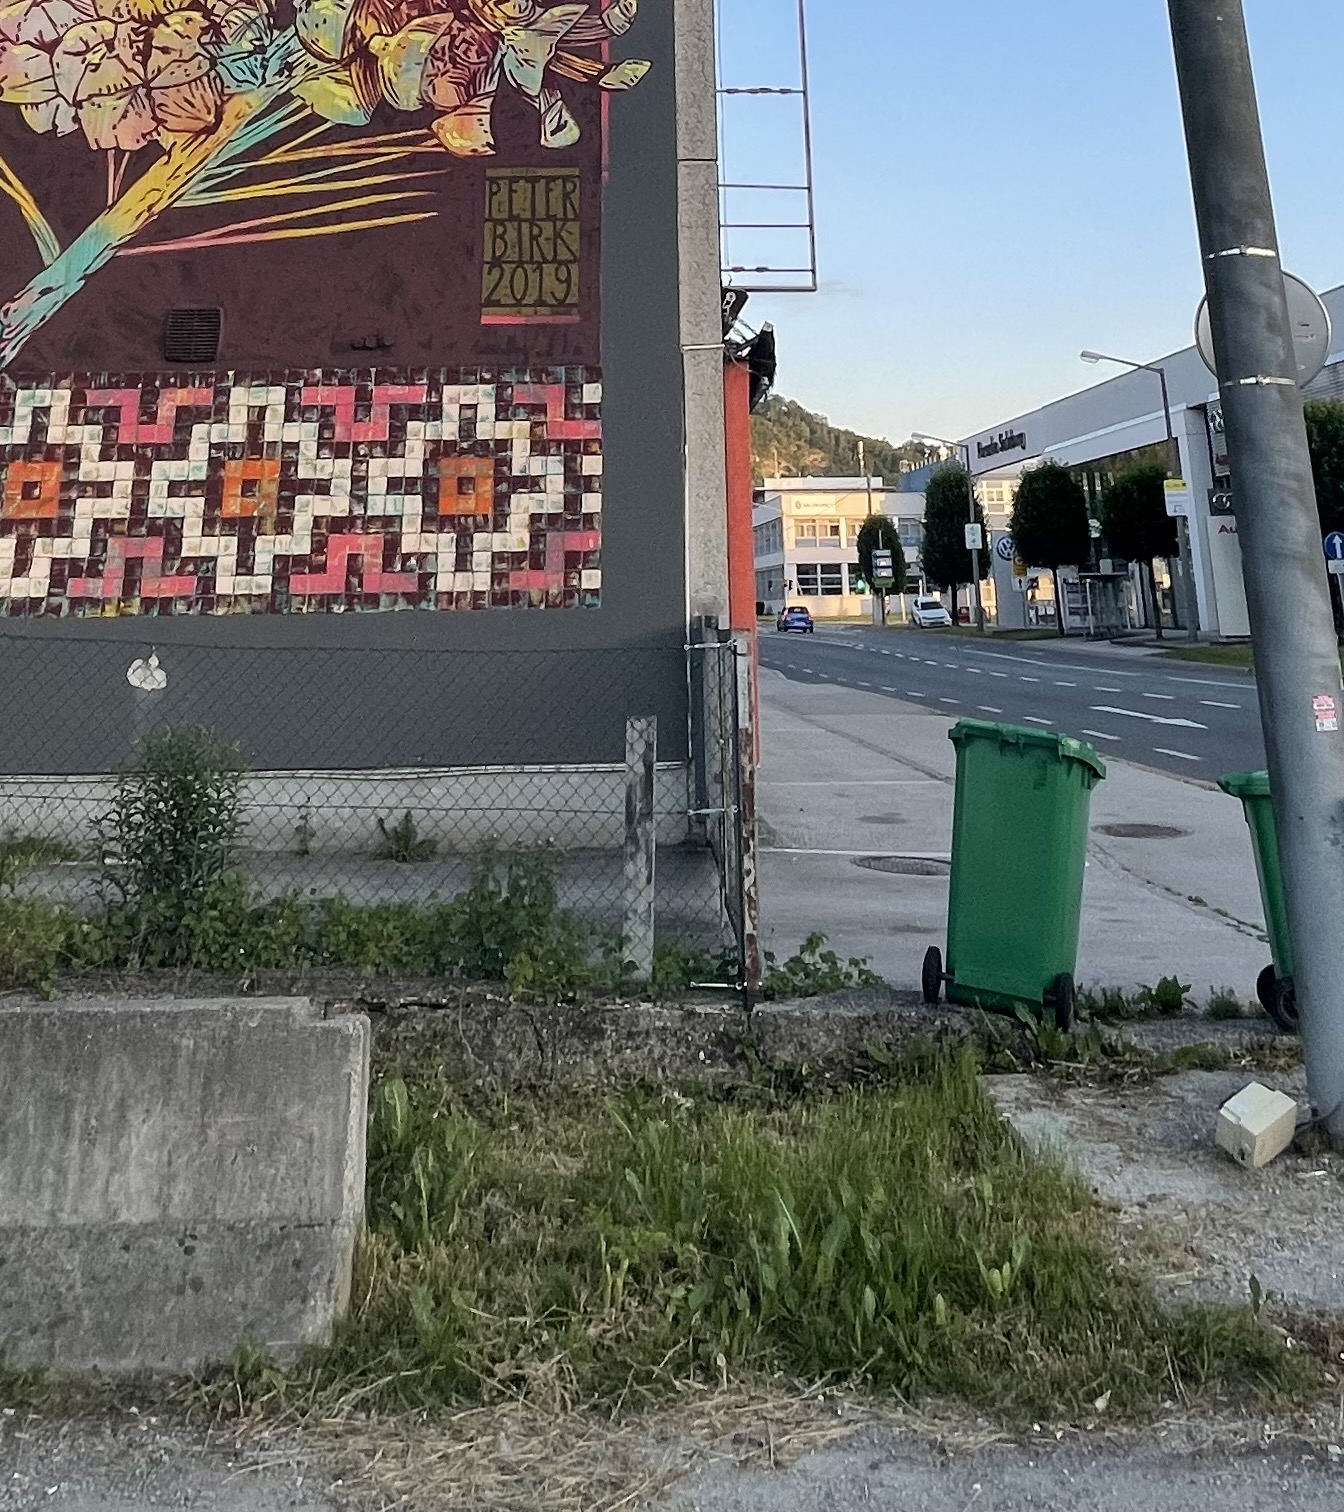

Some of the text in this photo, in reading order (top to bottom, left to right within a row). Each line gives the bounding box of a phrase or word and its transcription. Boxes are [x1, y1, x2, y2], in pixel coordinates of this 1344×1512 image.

[487, 176, 578, 220] PETER
[492, 219, 578, 262] BIRK
[483, 262, 572, 305] 2019
